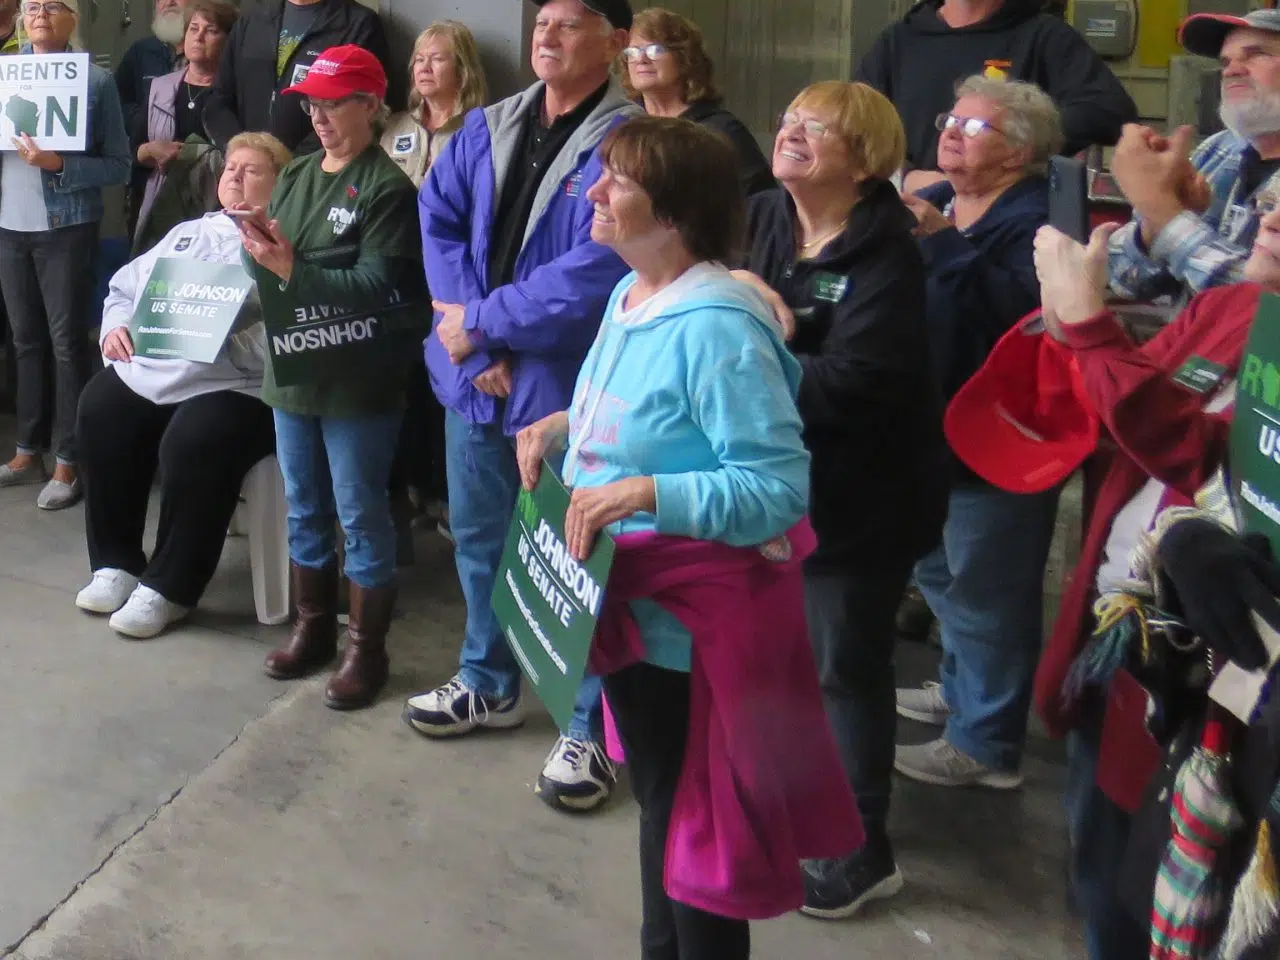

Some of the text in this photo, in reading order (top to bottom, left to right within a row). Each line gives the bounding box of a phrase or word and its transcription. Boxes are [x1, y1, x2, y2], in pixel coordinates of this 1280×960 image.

[151, 301, 219, 318] US SENATE
[173, 283, 246, 303] JOHNSON
[272, 317, 378, 355] JOHNSON
[518, 533, 530, 565] US
[527, 555, 573, 629] SENATE
[533, 518, 600, 616] JOHNSON
